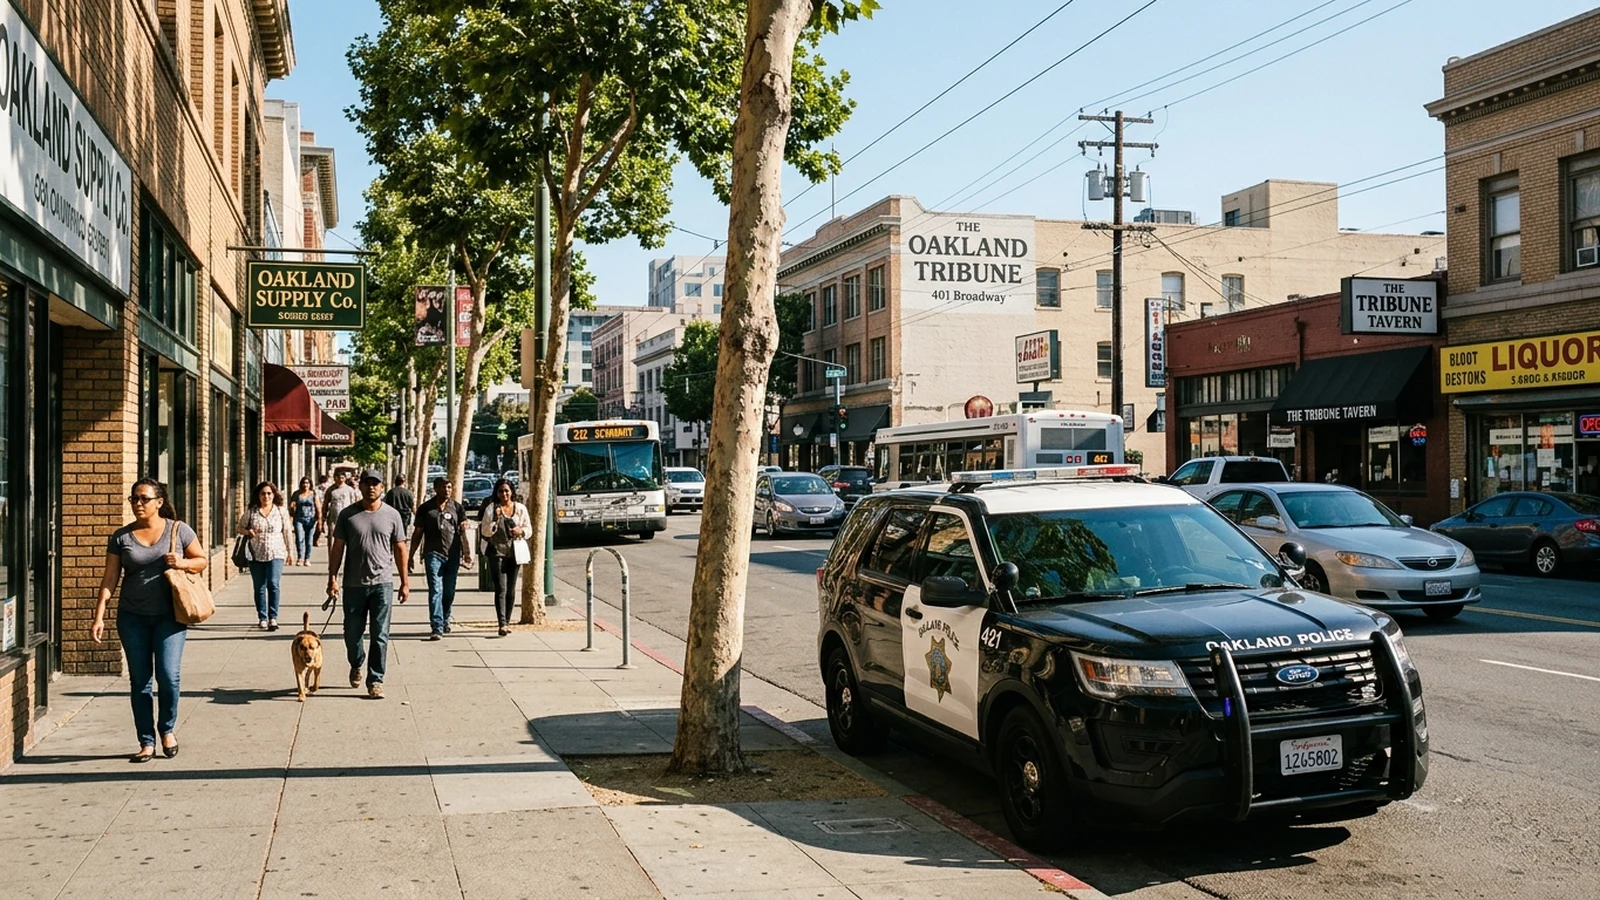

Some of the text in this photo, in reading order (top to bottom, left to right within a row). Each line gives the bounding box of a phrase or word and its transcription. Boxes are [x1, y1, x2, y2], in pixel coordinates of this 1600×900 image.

[0, 23, 71, 174] OAKLAND
[75, 120, 114, 221] SUPPLY
[956, 222, 980, 232] THE
[908, 235, 1028, 258] OAKLAND
[258, 270, 355, 289] OAKLAND
[914, 261, 1022, 284] TRIBUNE
[932, 290, 1006, 304] 401 Broadway
[1383, 283, 1405, 293] THE
[256, 290, 357, 309] SUPPLY Co.
[1356, 295, 1433, 313] TRIBUNE
[1368, 315, 1422, 328] TAVERN
[1450, 351, 1478, 367] BLOOT
[1492, 335, 1600, 371] LIQUOR
[326, 400, 347, 408] PAN
[1287, 410, 1303, 422] THE
[1342, 405, 1377, 419] TAVERN
[981, 627, 1002, 649] 421
[1205, 635, 1292, 652] OAKLAND
[1285, 748, 1338, 770] 1265802
